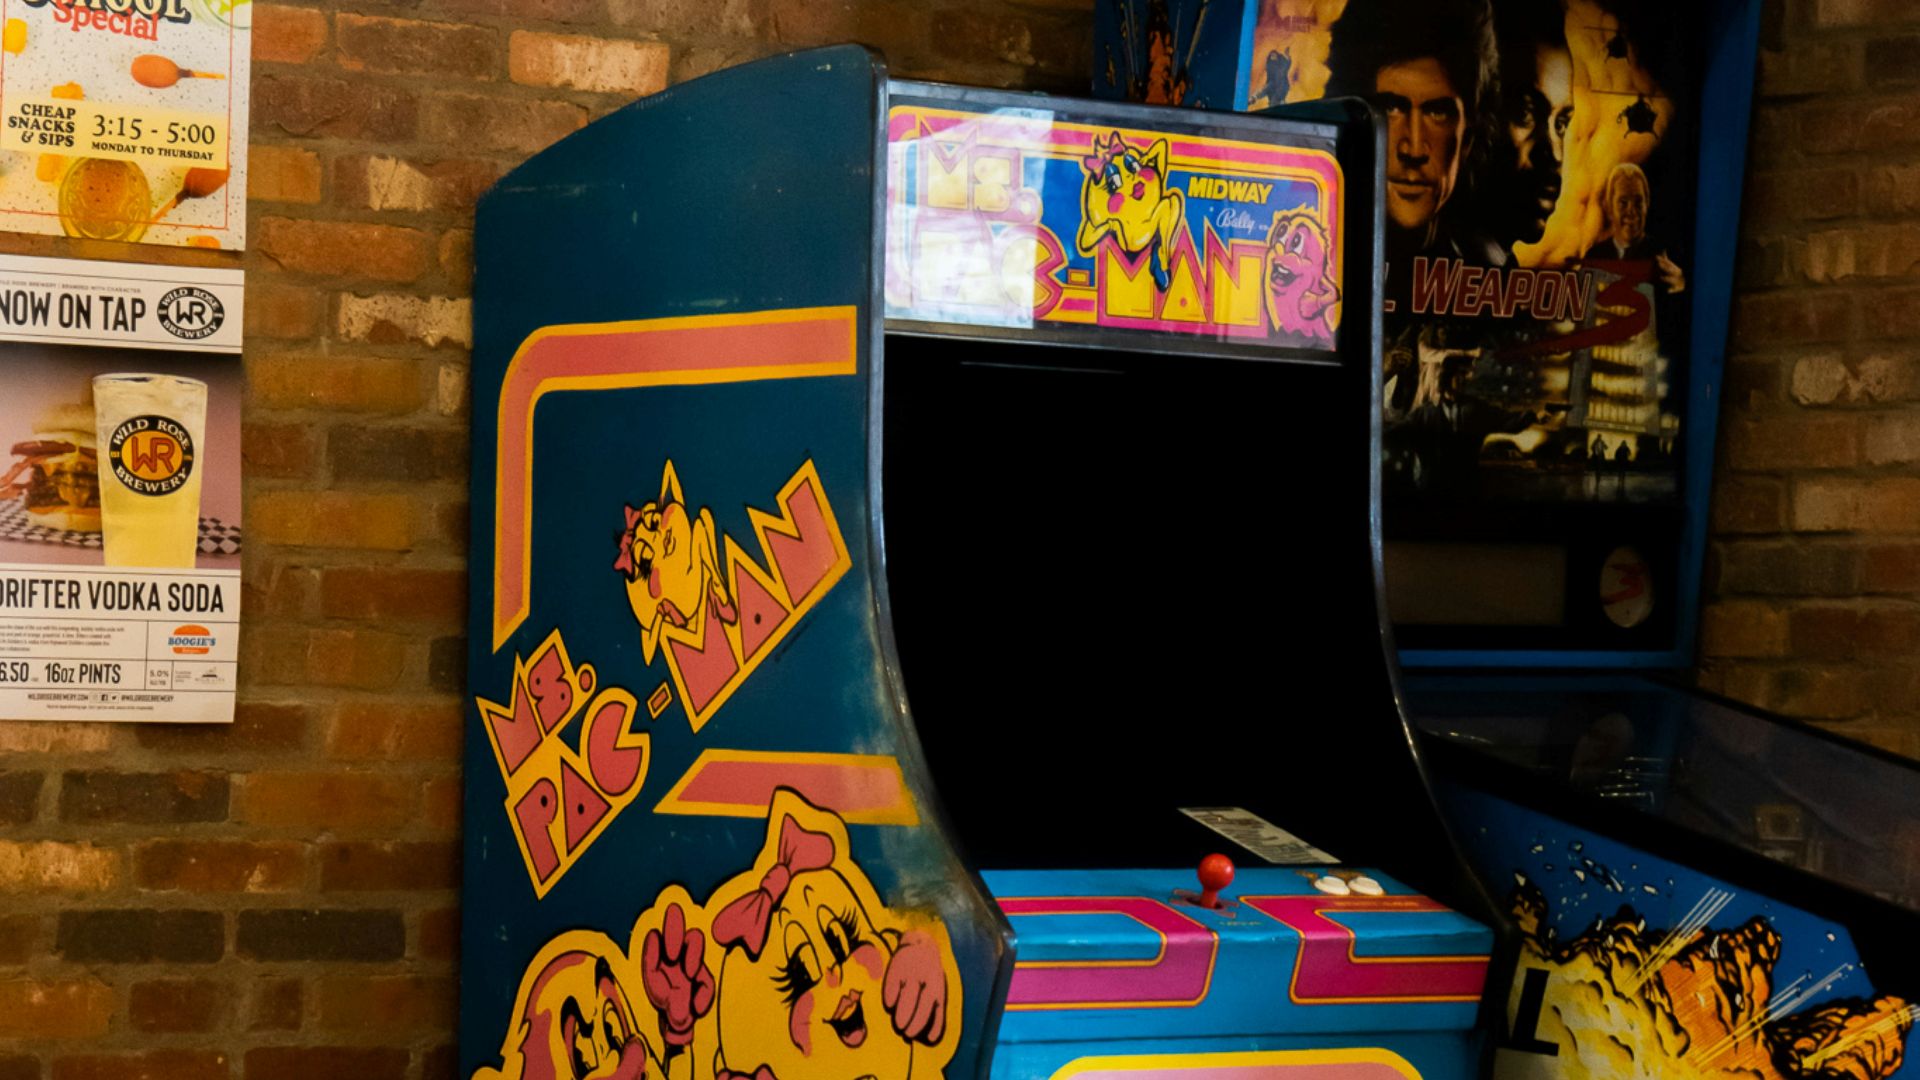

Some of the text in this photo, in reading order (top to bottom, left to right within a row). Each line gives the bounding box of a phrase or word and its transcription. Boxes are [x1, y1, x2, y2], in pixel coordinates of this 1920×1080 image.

[52, 1, 159, 41] Special
[8, 115, 75, 133] SNACKS
[21, 103, 76, 119] CHEAP
[21, 130, 75, 147] & SIPS
[92, 114, 142, 140] 3:15
[166, 122, 215, 145] 5:00
[92, 141, 214, 161] MONDAY TO THURSDAY
[1187, 176, 1273, 205] MIDWAY
[1215, 208, 1255, 235] Bally
[162, 289, 219, 309] WILD ROSE
[1412, 256, 1592, 321] WEAPON
[0, 290, 146, 332] NOW ON TAP
[176, 300, 206, 325] WR
[163, 320, 217, 339] BREWERY
[113, 419, 190, 450] WILD ROSE
[131, 436, 175, 473] WR
[116, 466, 188, 492] BREWERY
[0, 578, 224, 613] RIFTER VODKA SODA
[168, 636, 216, 647] BOOGIE'S
[79, 663, 122, 685] PINTS
[476, 628, 597, 779] MS.
